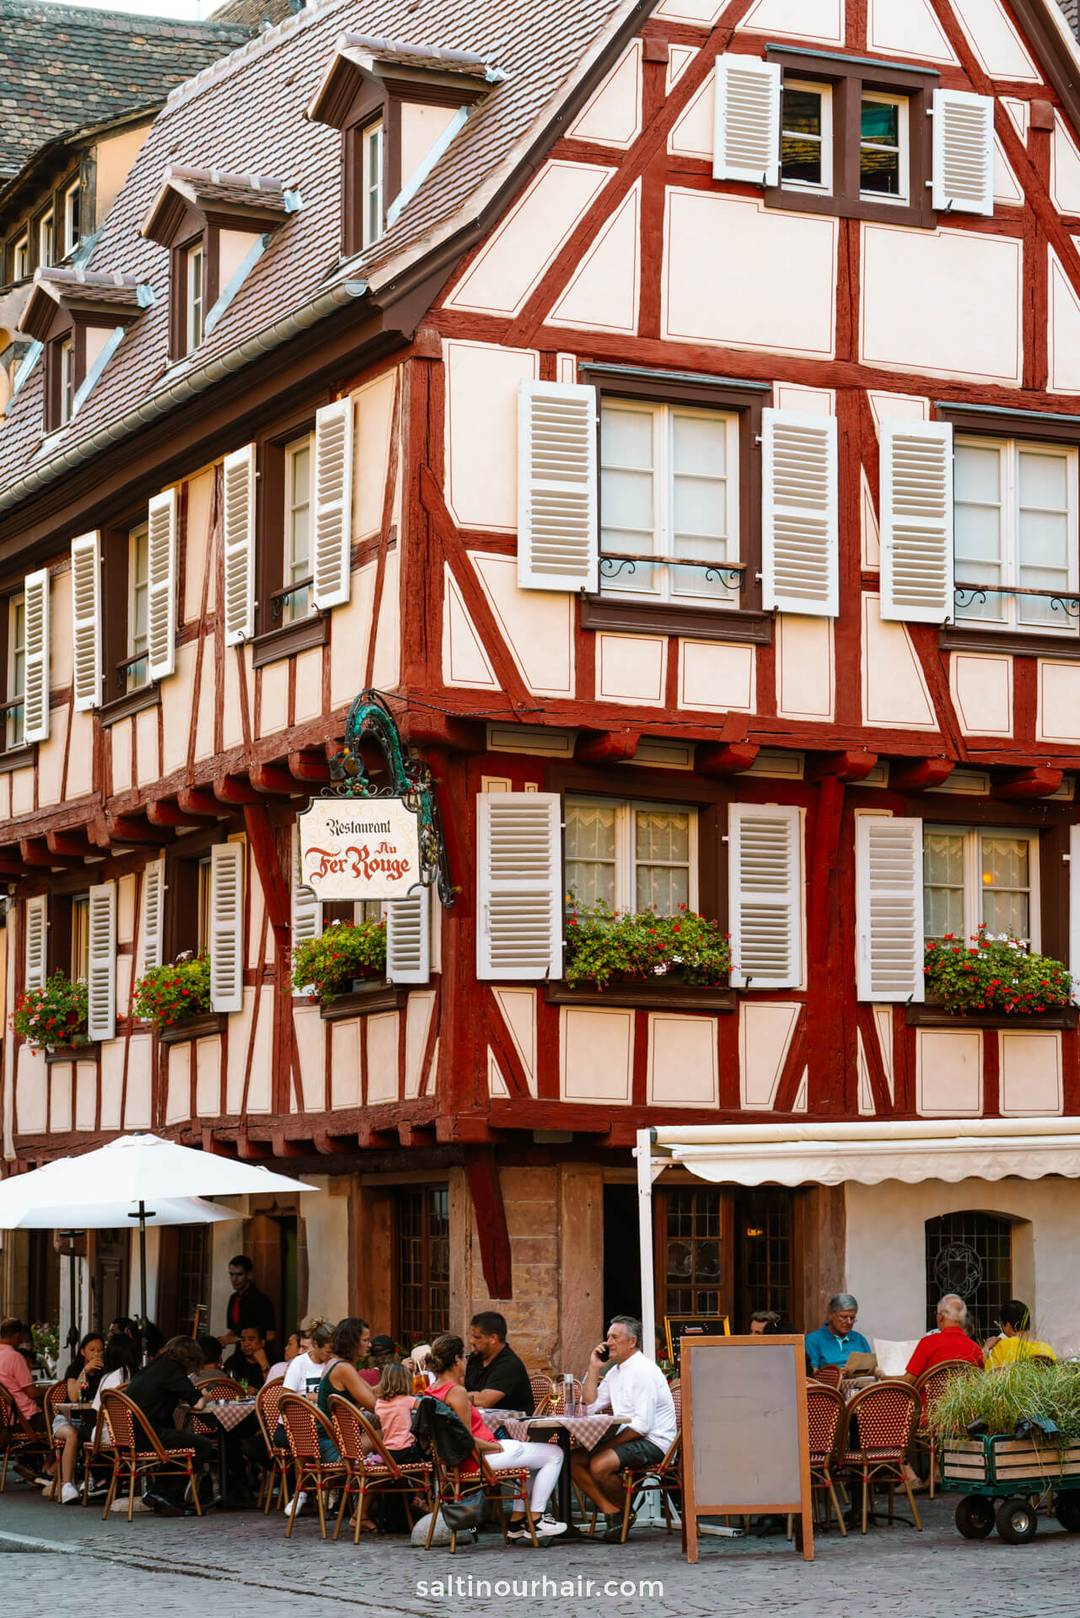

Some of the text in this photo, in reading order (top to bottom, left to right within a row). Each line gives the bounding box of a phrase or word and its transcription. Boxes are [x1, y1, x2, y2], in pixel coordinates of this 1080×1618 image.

[326, 818, 391, 836] Restaurant
[375, 841, 397, 854] Au
[305, 845, 410, 884] Fer Rouge
